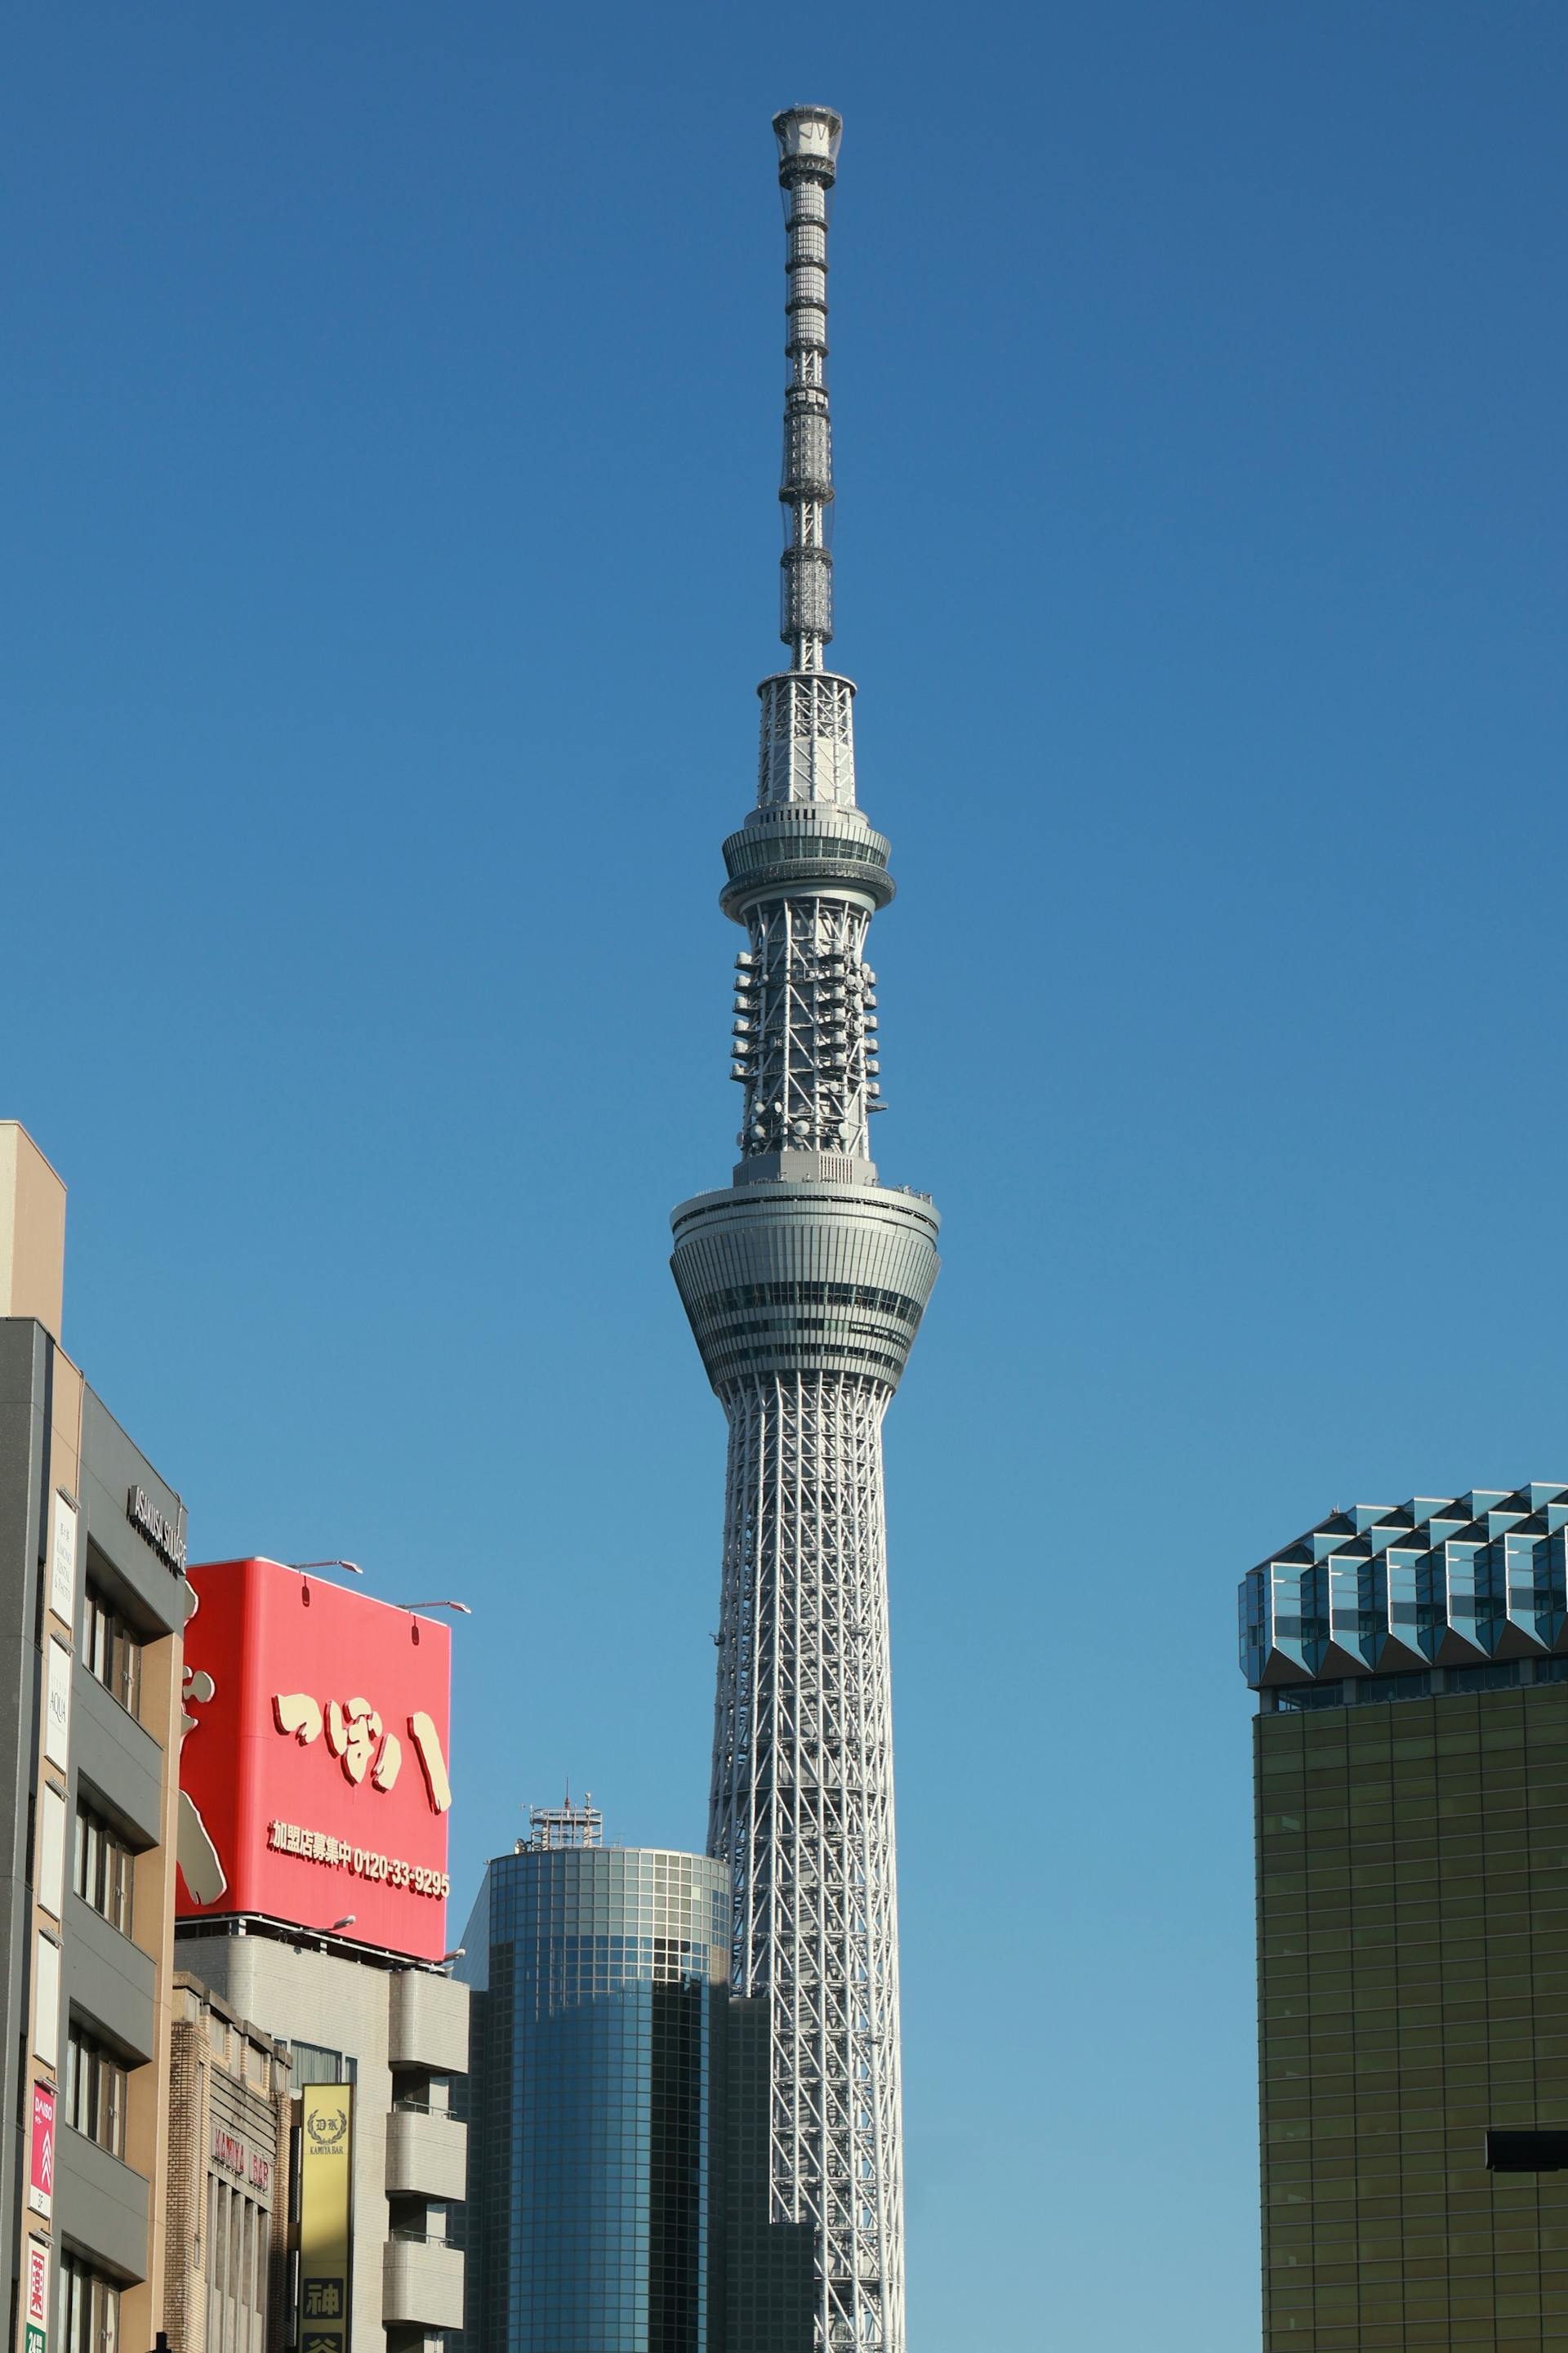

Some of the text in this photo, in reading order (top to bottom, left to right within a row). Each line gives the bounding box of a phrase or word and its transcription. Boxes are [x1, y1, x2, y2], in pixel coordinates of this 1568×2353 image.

[135, 1486, 186, 1575] ASAKUSA SQUARE
[50, 1690, 66, 1723] AQUA
[275, 1693, 452, 1813] つぼ八
[272, 1820, 450, 1898] 加盟店募集中 0120-33-9295
[34, 2096, 53, 2122] DAISO
[215, 2128, 269, 2190] KAMIYA BAR
[310, 2146, 344, 2155] KAMIYA BAR
